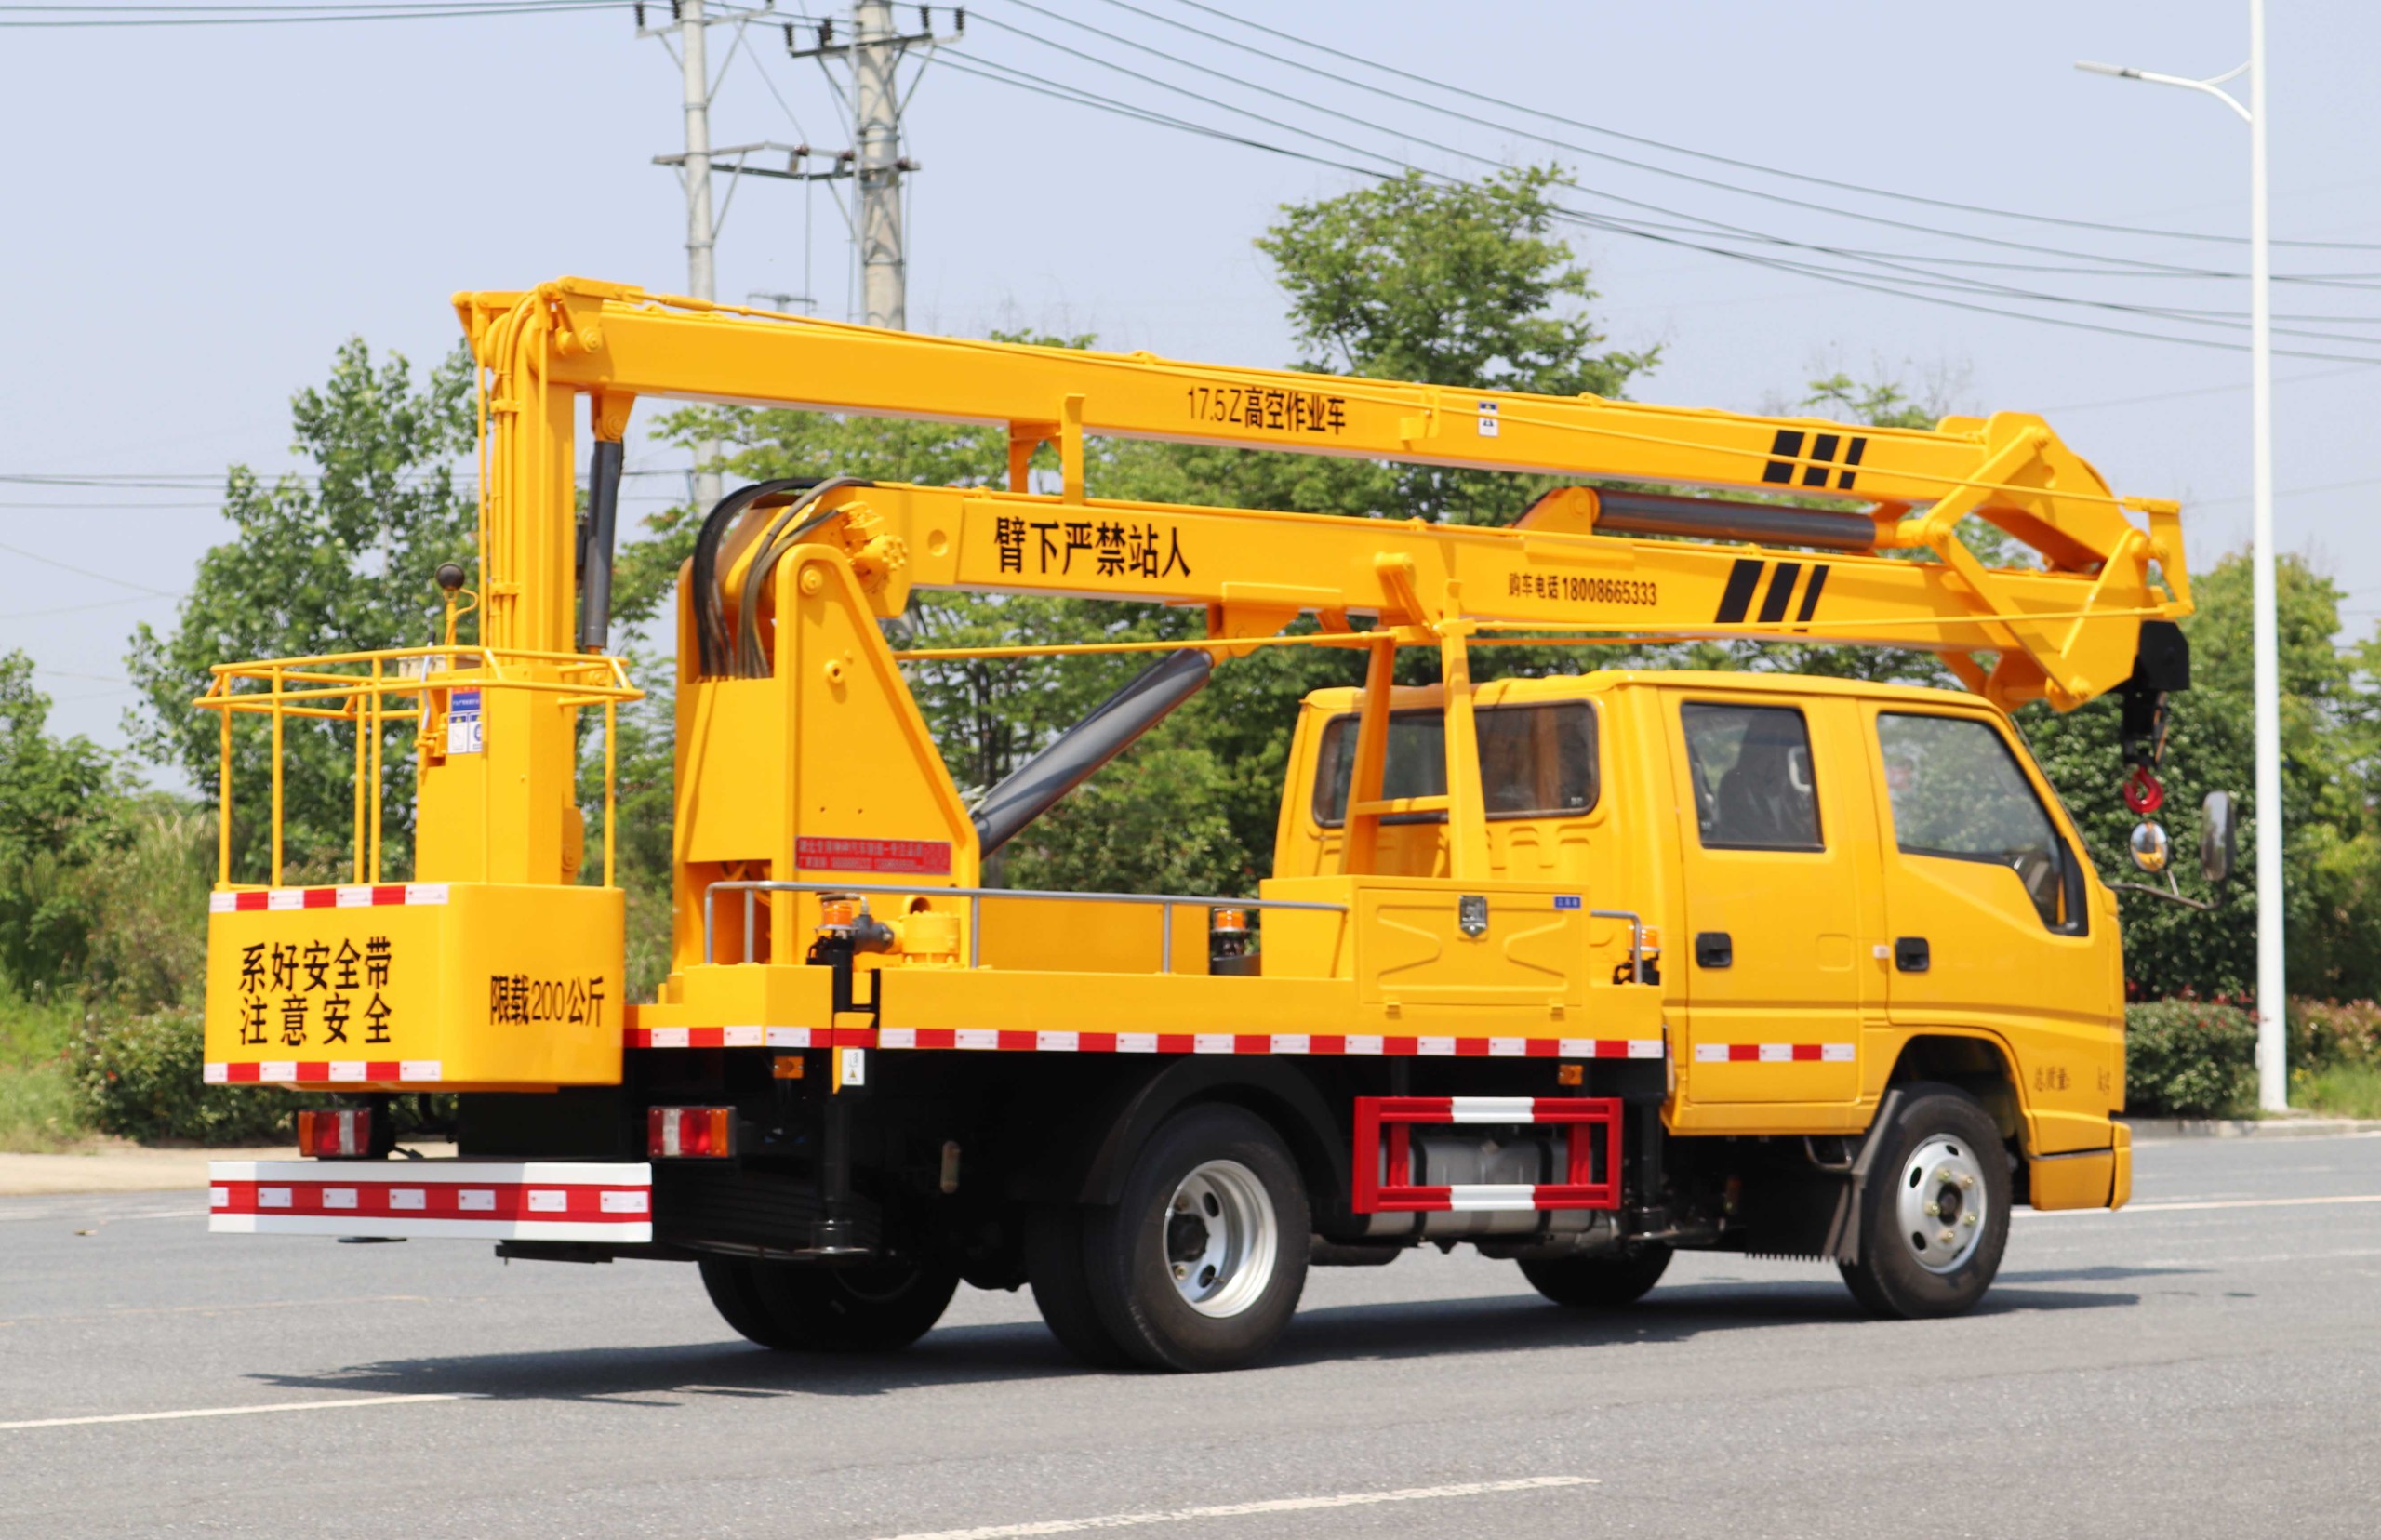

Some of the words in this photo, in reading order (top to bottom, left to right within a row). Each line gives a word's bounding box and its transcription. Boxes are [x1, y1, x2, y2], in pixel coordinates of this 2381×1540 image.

[1188, 386, 1346, 435] 17.5Z高空作业车
[994, 516, 1190, 578] 臂下严禁站人
[238, 936, 392, 994] 系好安全带
[239, 992, 392, 1046] 注意安全
[490, 974, 605, 1028] 限载200公斤
